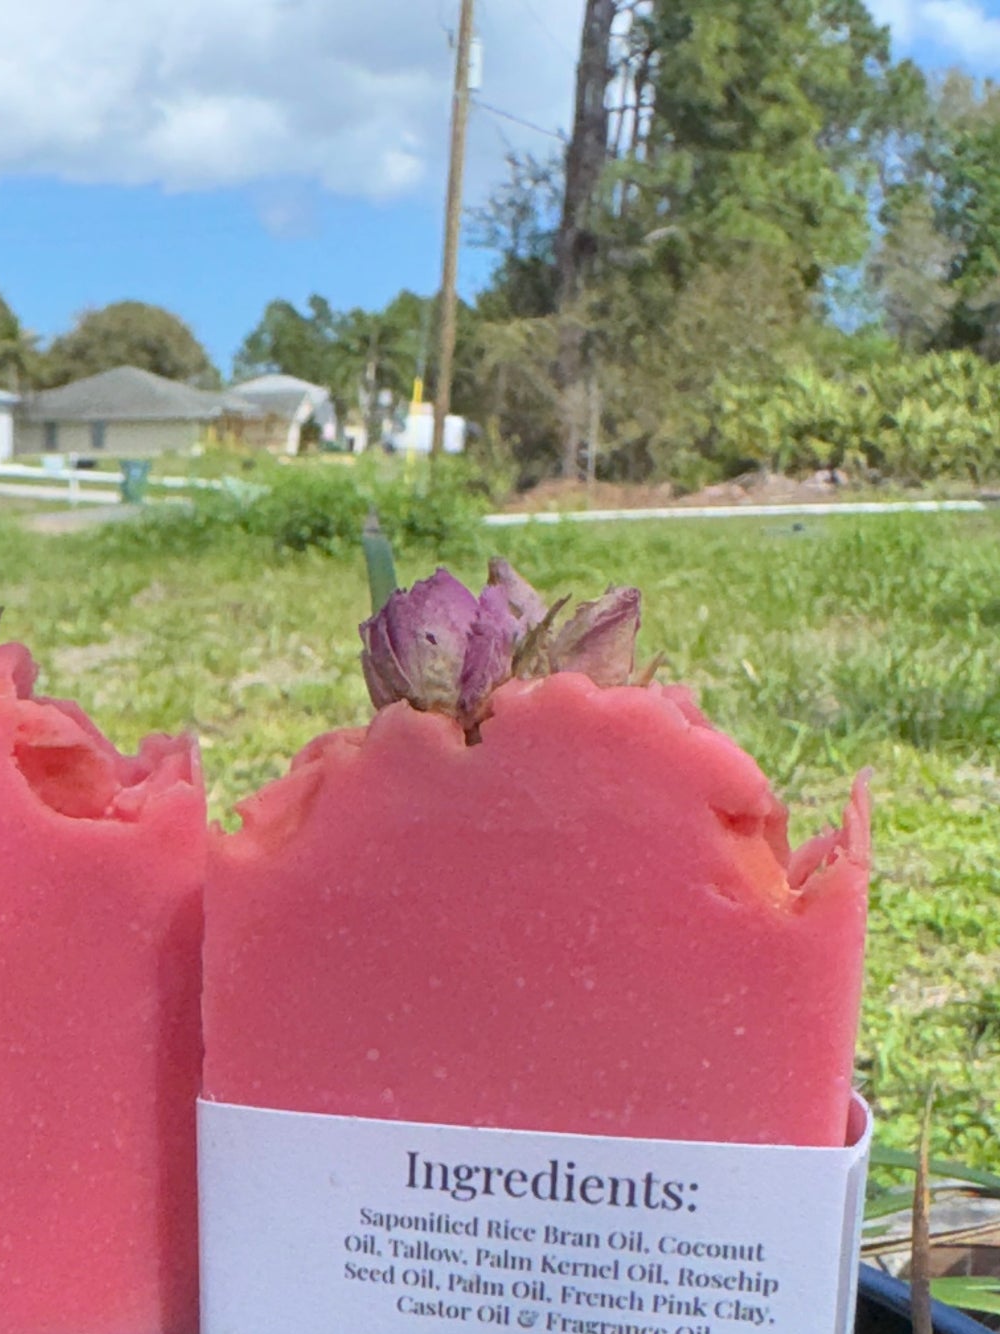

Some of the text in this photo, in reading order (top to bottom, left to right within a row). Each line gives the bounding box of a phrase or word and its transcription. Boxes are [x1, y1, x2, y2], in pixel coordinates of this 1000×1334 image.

[408, 1151, 699, 1212] Ingredients:
[359, 1207, 765, 1262] Saponified Rice Bran Oil, Coconut
[344, 1234, 383, 1257] Oil,
[476, 1246, 535, 1271] Palm
[541, 1253, 621, 1281] Kernel
[626, 1261, 671, 1287] Oil,
[677, 1266, 779, 1297] Rosehip
[344, 1261, 395, 1286] Seed
[401, 1267, 442, 1291] Oil,
[447, 1273, 505, 1297] Palm
[511, 1279, 554, 1303] Oil,
[560, 1284, 645, 1313] French
[651, 1292, 708, 1318] Pink
[396, 1295, 472, 1321] Castor
[477, 1303, 510, 1326] Oil
[517, 1308, 540, 1328] &
